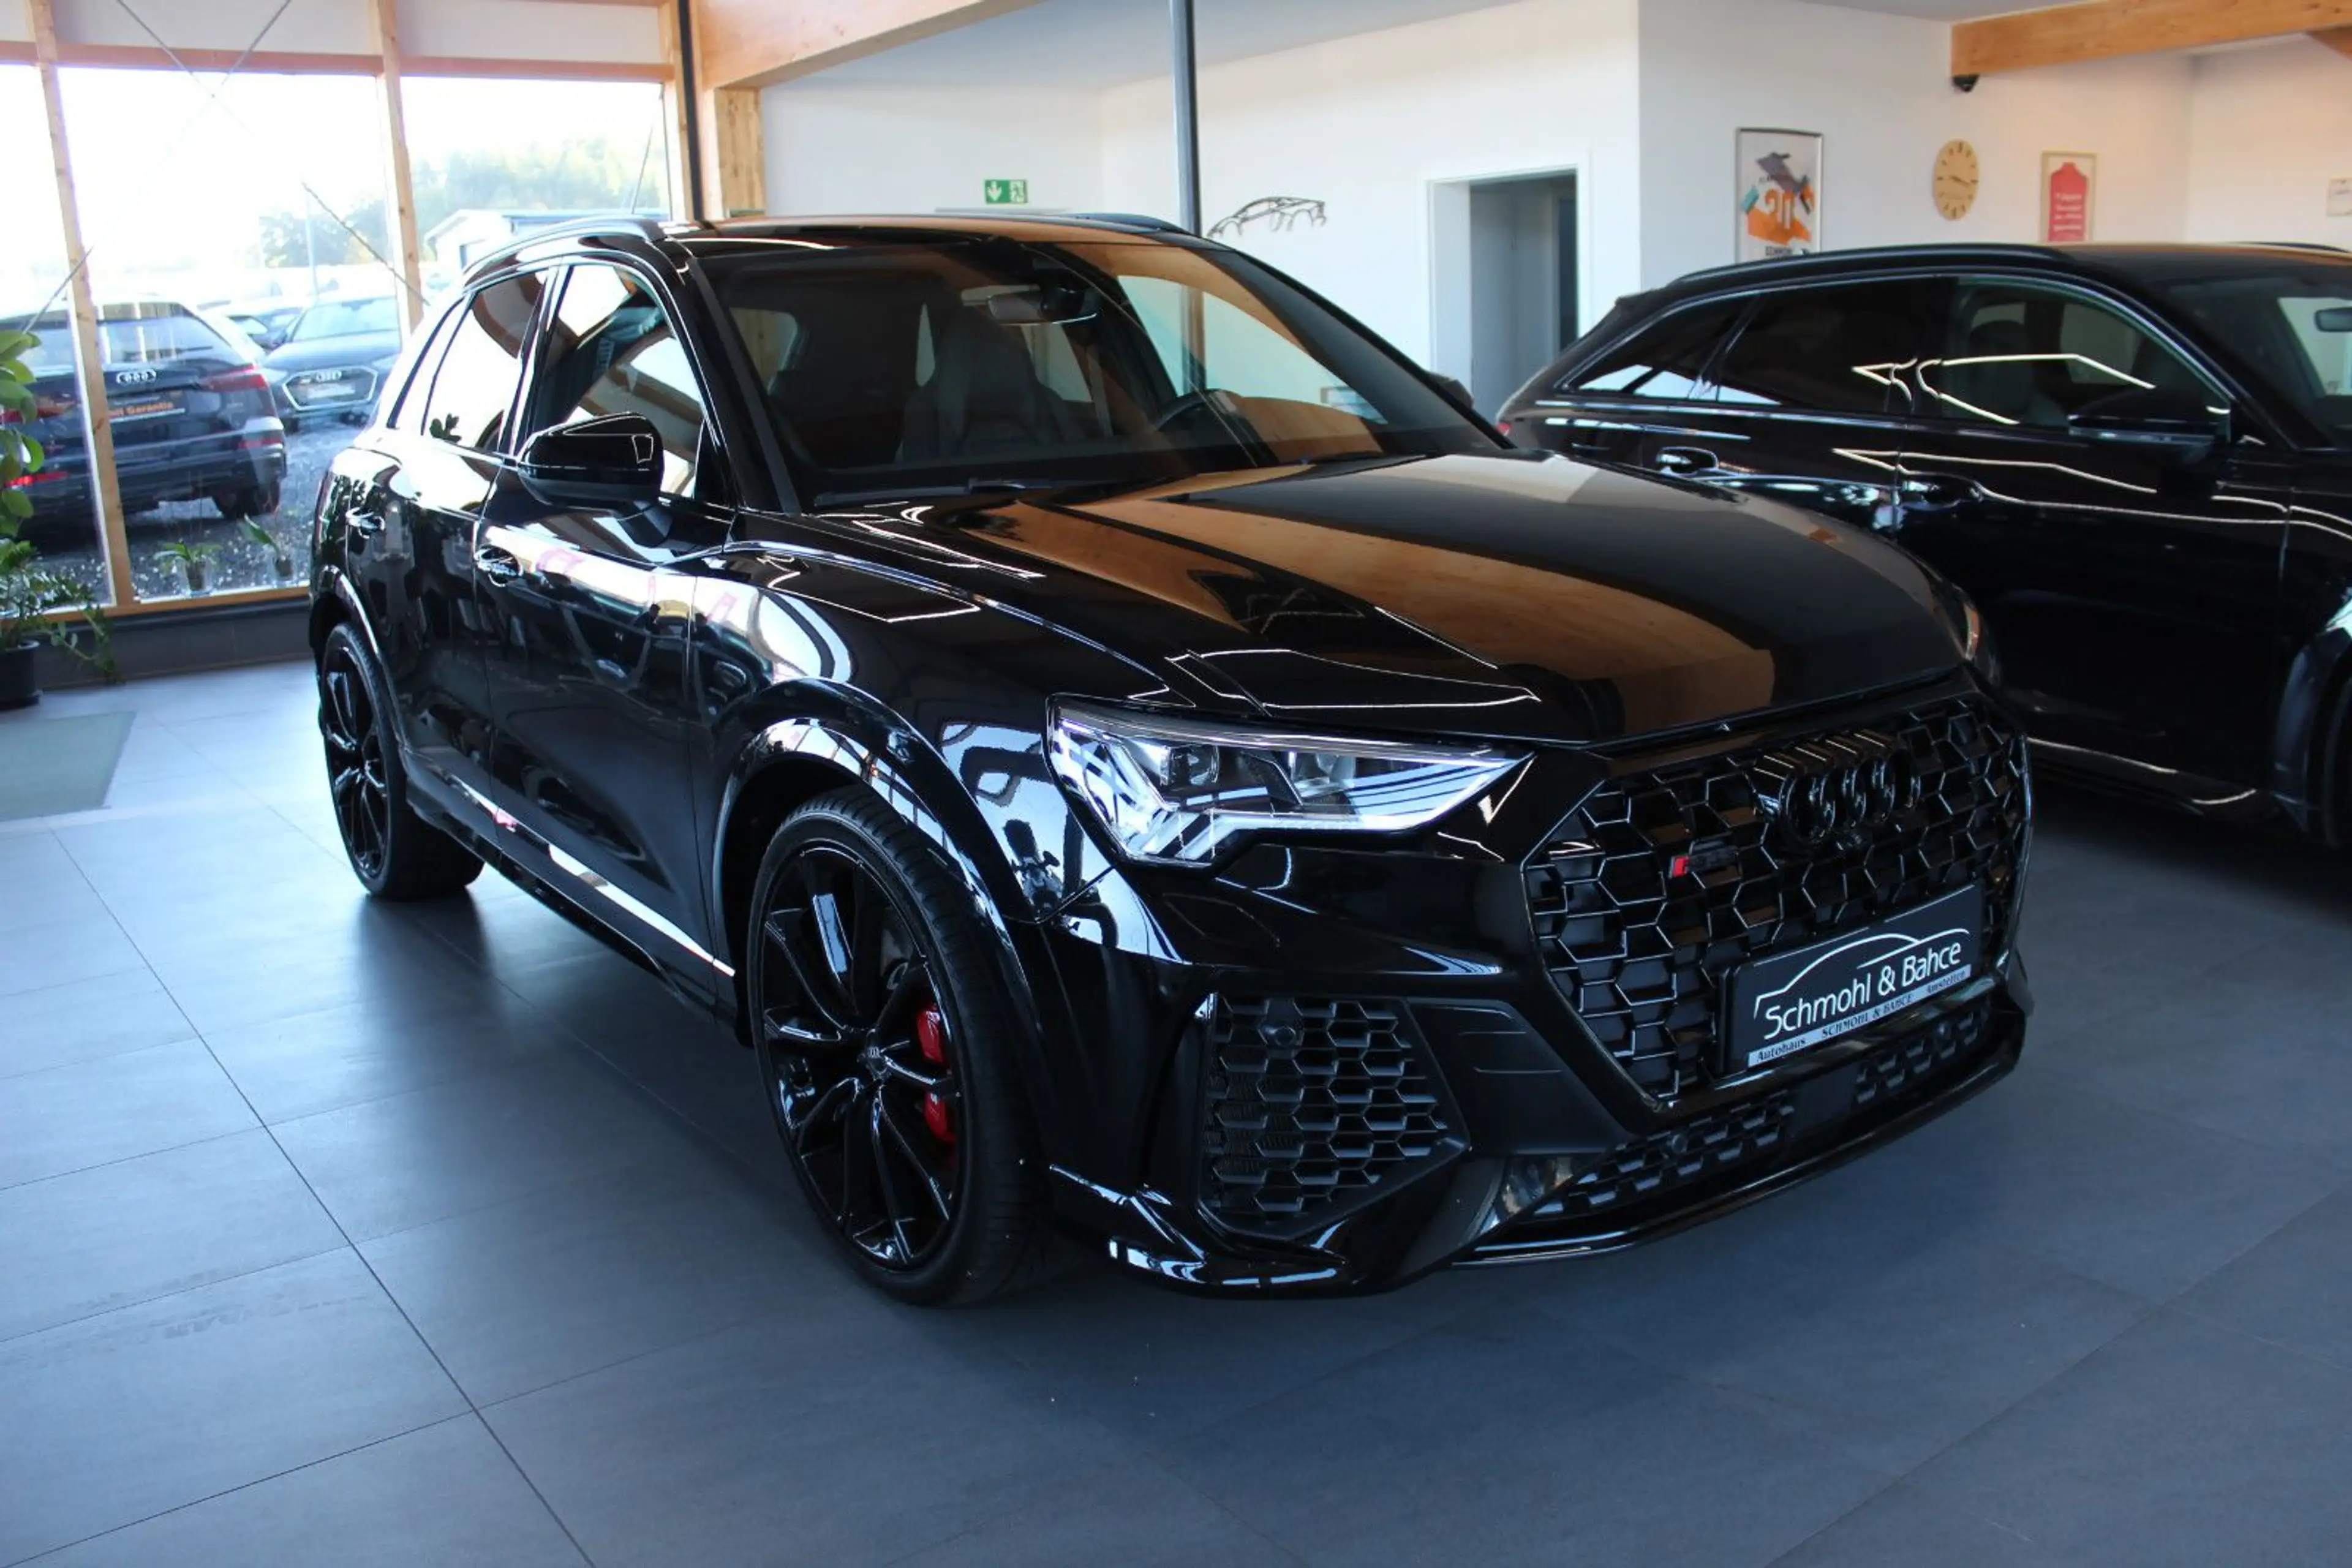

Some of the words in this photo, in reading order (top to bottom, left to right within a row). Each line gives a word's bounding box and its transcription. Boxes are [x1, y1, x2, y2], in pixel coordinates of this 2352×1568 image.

[1763, 973, 1871, 1040] Schmohl
[1877, 965, 1896, 997] &
[1901, 941, 1961, 987] Bahce
[1757, 1037, 1807, 1063] Autohaus
